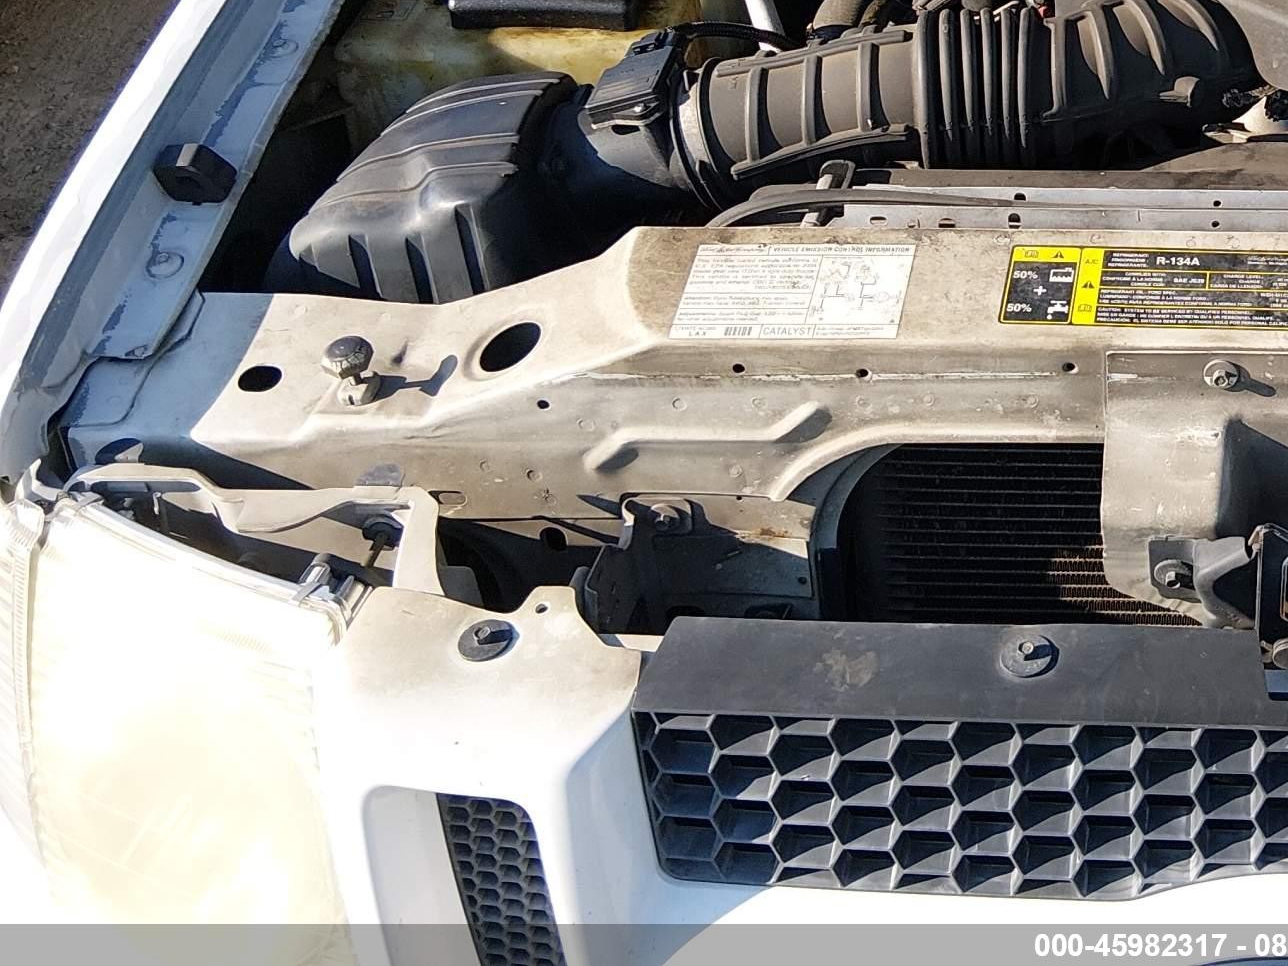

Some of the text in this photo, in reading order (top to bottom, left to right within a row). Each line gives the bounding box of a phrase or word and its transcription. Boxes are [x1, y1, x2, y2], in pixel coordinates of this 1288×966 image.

[1156, 256, 1200, 266] R-134A
[1013, 270, 1039, 280] 50%
[1006, 303, 1032, 313] 50%
[763, 327, 812, 336] CATALYST
